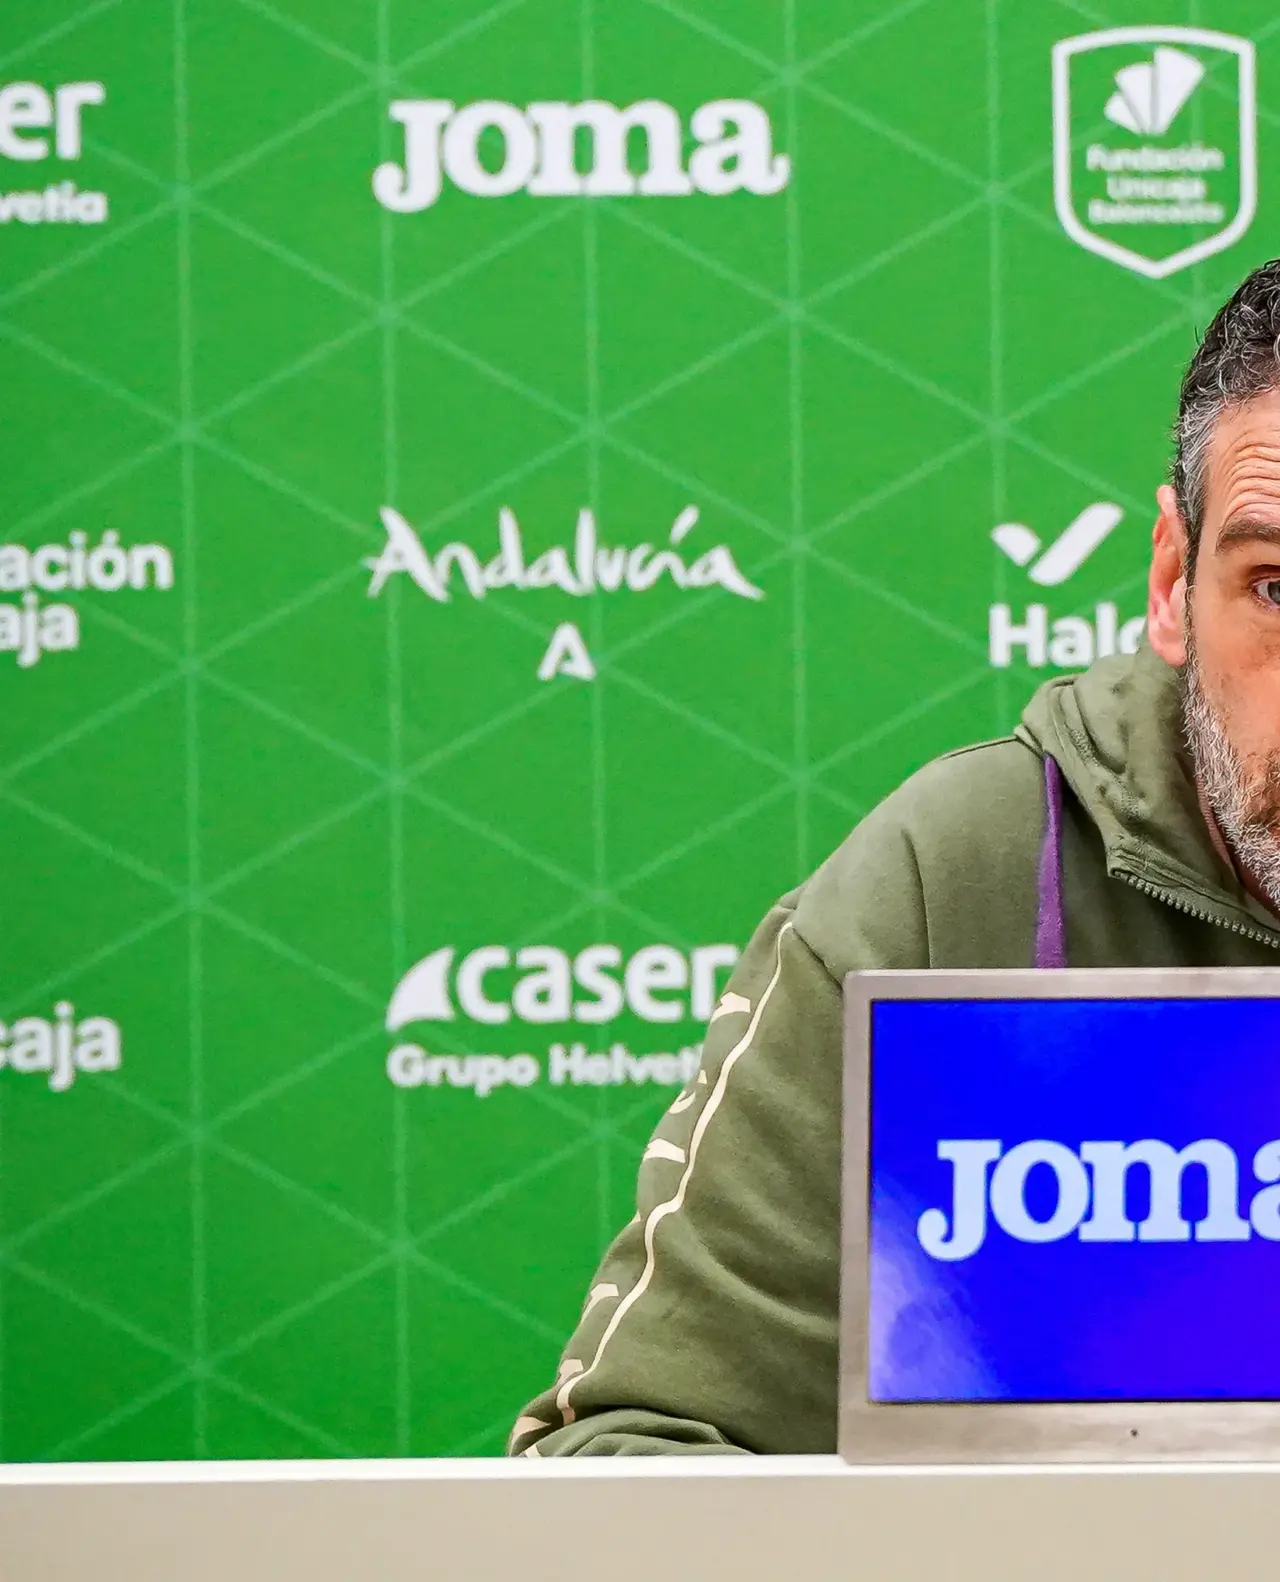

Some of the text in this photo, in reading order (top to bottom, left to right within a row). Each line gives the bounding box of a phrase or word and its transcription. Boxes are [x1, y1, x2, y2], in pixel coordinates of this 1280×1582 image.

[372, 97, 792, 214] Joma
[363, 505, 763, 602] Andalucía
[537, 622, 597, 681] A
[455, 943, 737, 1027] caser
[0, 1001, 121, 1092] aja
[386, 1042, 540, 1098] Grupo
